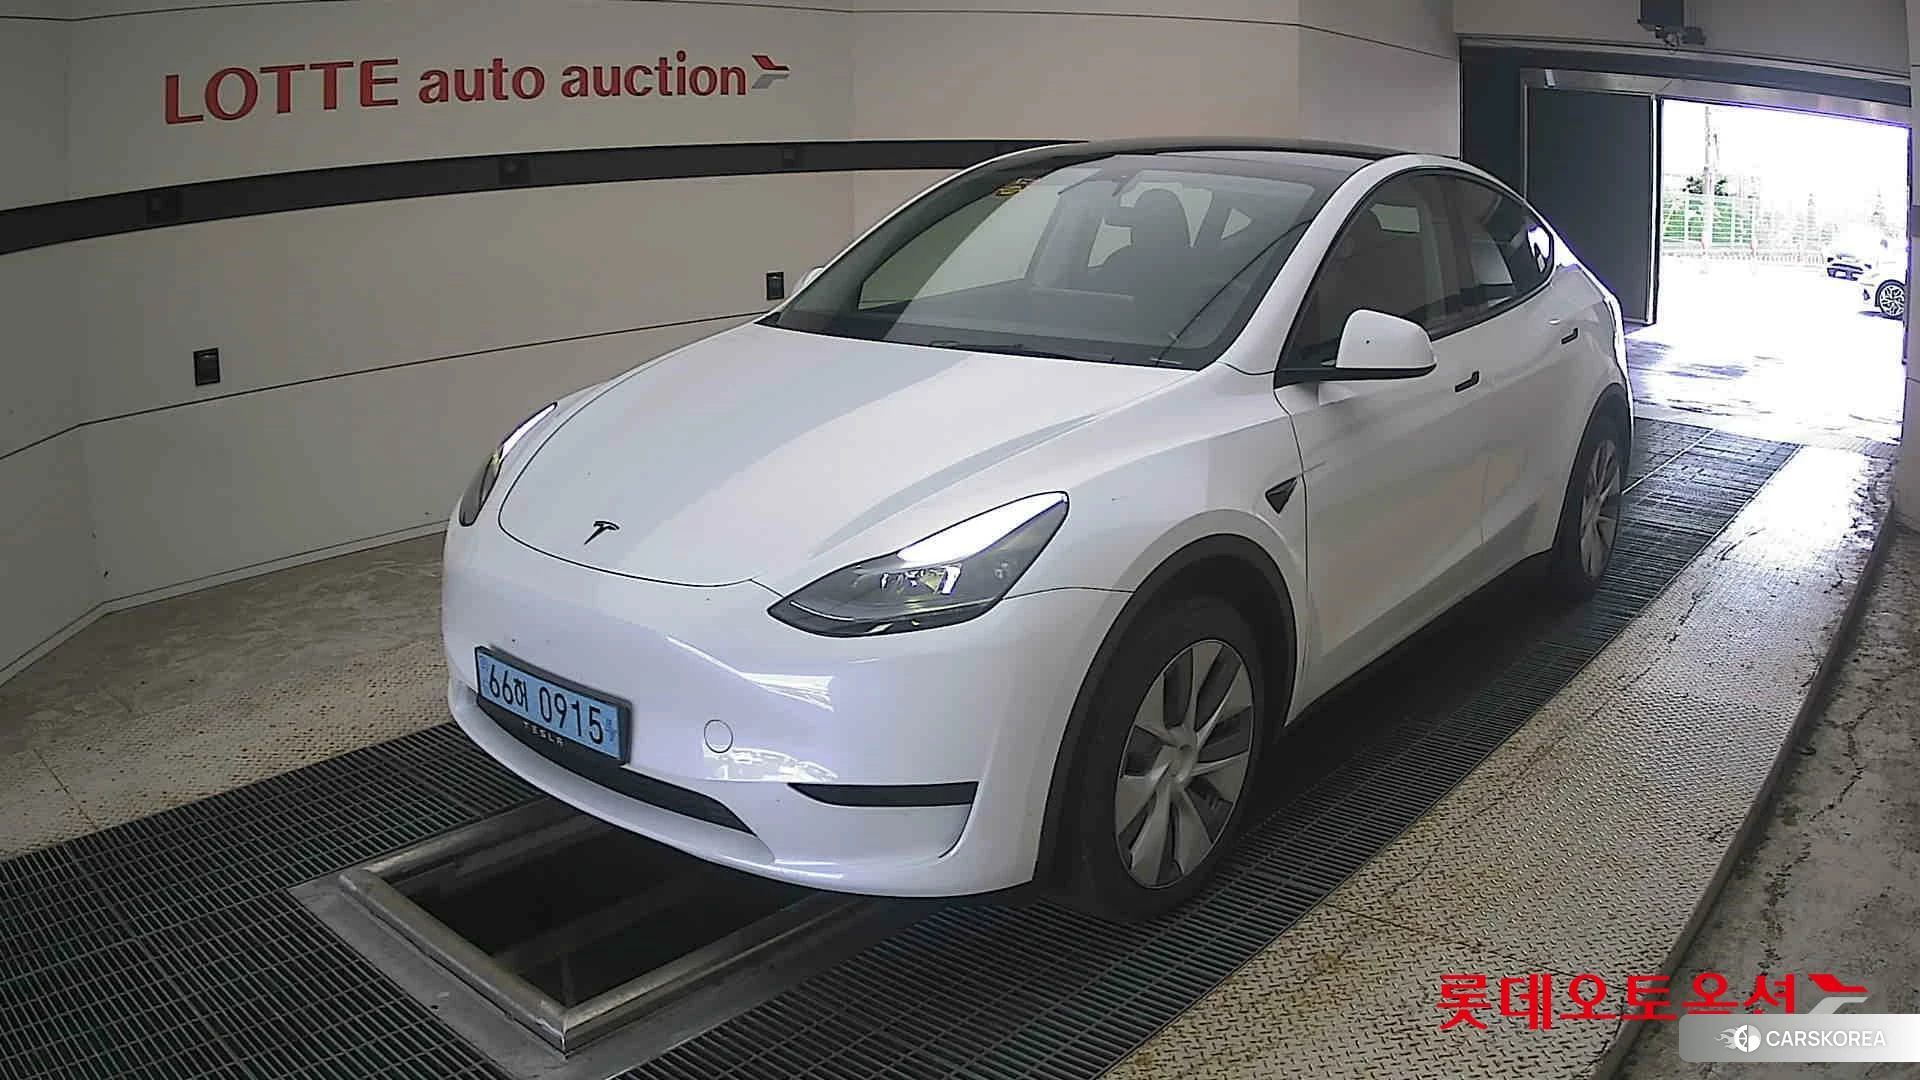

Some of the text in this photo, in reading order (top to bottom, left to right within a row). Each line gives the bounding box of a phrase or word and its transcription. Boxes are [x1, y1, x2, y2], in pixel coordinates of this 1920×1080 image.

[165, 50, 748, 125] LOTTE auto auction
[539, 687, 604, 745] 0915
